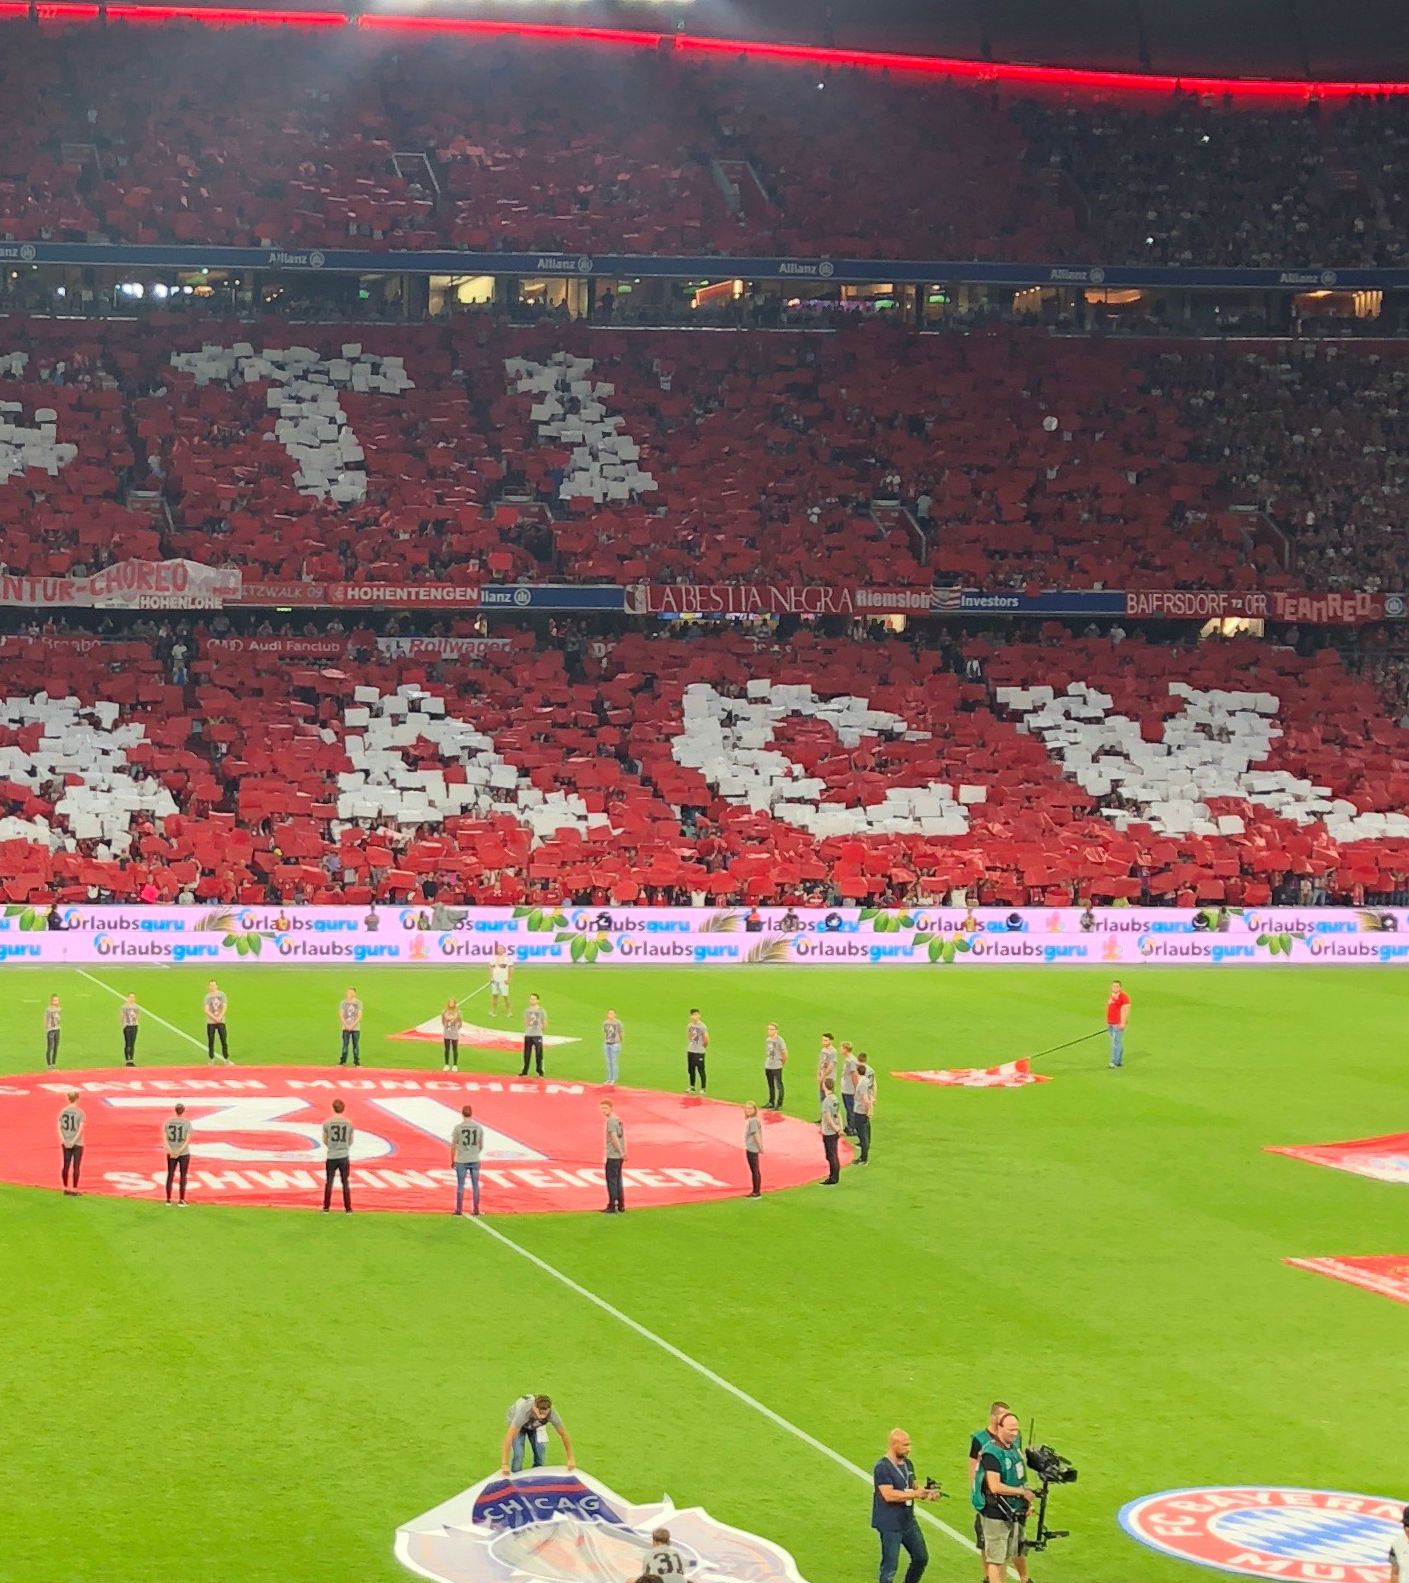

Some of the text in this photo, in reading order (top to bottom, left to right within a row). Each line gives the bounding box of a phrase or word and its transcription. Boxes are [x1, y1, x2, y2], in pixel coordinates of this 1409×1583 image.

[268, 253, 308, 265] Allianz
[537, 259, 576, 270] Allianz
[779, 263, 818, 274] Allianz
[1050, 269, 1088, 280] Allianz
[1279, 272, 1319, 284] Allianz
[242, 585, 302, 599] ITZWALK
[347, 586, 478, 601] HOHENTENGEN
[480, 590, 513, 602] lianz
[767, 586, 854, 613] NEGRA
[961, 594, 1020, 607] Investors
[140, 596, 224, 609] HOHENLOHE
[248, 640, 341, 652] Audi Fanclub
[67, 914, 186, 931] Urlaubsguru
[1095, 914, 1194, 931] rlaubsguru
[1248, 914, 1358, 931] Urlaubsguru
[97, 939, 219, 961] Urlaubsguru
[278, 939, 400, 961] Urlaubsguru
[620, 939, 739, 961] Urlaubsguru
[796, 939, 915, 961] Urlaubsguru
[972, 939, 1088, 961] Urlaubsguru
[36, 1080, 269, 1094] BAYERN
[60, 1113, 77, 1131] 31
[167, 1124, 184, 1143] 31
[329, 1124, 348, 1142] 31
[460, 1129, 480, 1146] 31
[652, 1552, 685, 1575] 31
